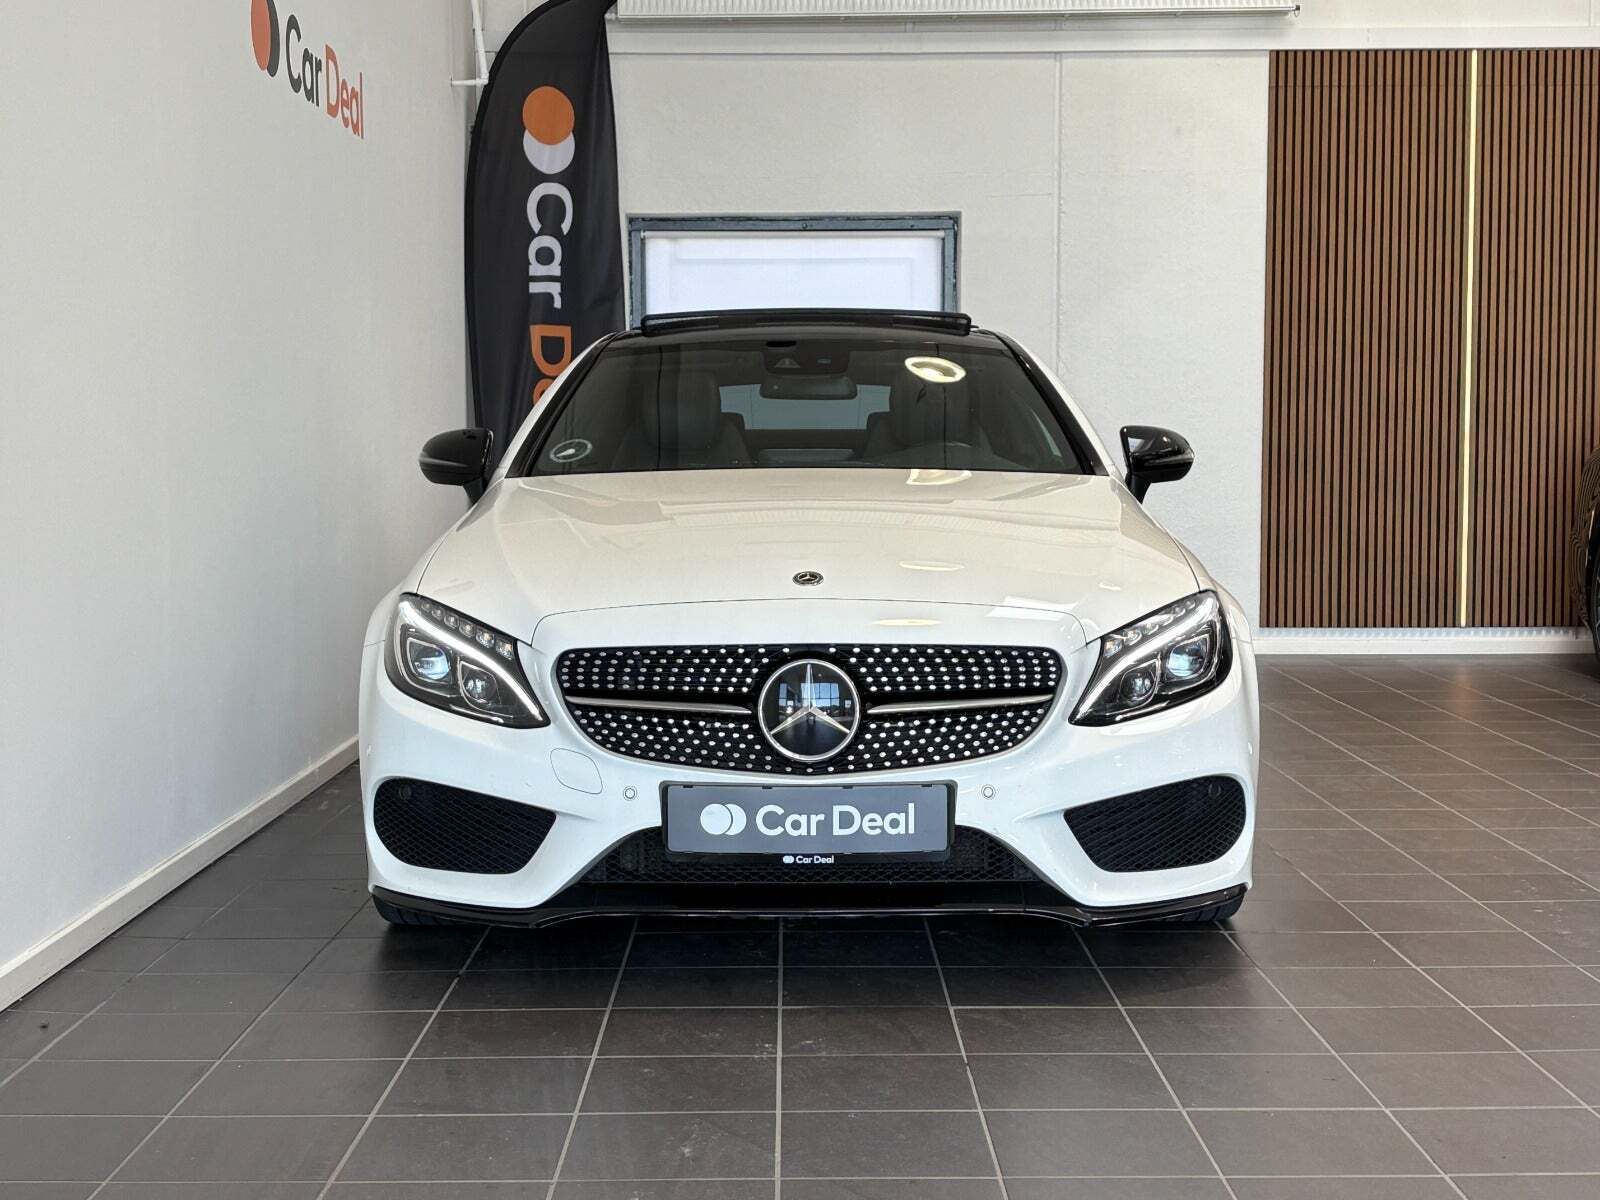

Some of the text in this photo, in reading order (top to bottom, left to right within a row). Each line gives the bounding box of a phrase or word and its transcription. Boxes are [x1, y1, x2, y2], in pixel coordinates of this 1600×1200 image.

[285, 14, 364, 140] Car Deal
[526, 182, 573, 309] Car
[755, 802, 915, 836] Car Deal
[795, 854, 835, 864] Car Deal
